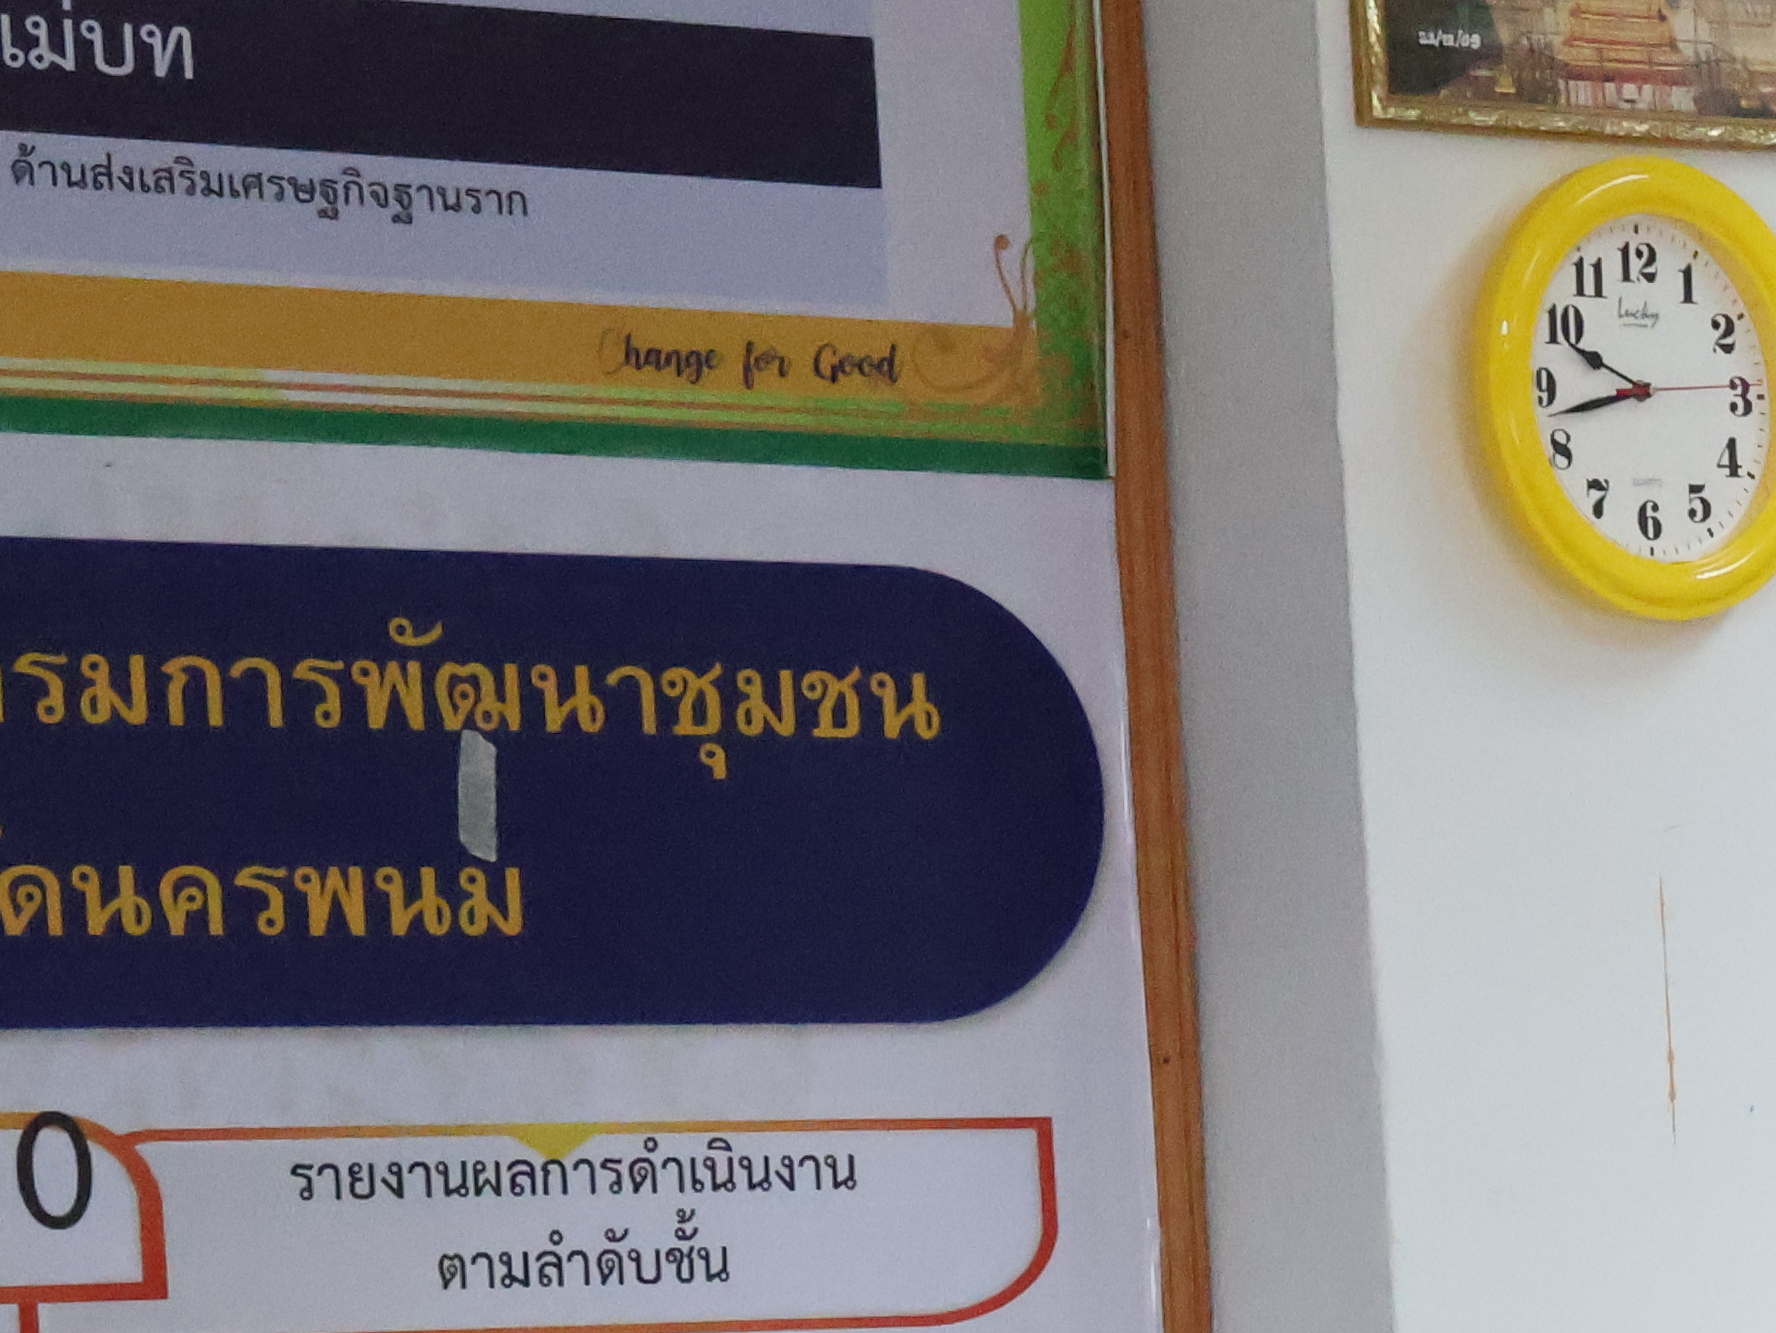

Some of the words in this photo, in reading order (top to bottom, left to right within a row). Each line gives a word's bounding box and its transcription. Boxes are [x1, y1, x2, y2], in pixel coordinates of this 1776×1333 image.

[10, 143, 527, 224] ด้านส่งเสริมเศรษฐกิจฐานราก
[1572, 256, 1607, 298] 11
[1617, 241, 1657, 283] 12
[1678, 263, 1698, 304] 1
[1545, 303, 1584, 345] 10
[1711, 313, 1736, 354] 2
[743, 340, 790, 390] for
[814, 342, 897, 384] Good
[1535, 366, 1556, 408] 9
[1729, 376, 1753, 417] 3
[1550, 429, 1573, 470] 8
[1717, 437, 1742, 478] 4
[1587, 478, 1609, 519] 7
[1688, 484, 1712, 523] 5
[1637, 500, 1662, 541] 6
[0, 617, 941, 779] รมการพัฒนาชุมชน
[289, 1142, 858, 1205] รายงานผลการดำเนินงาน
[437, 1209, 731, 1291] ตามลำดับชั้น
